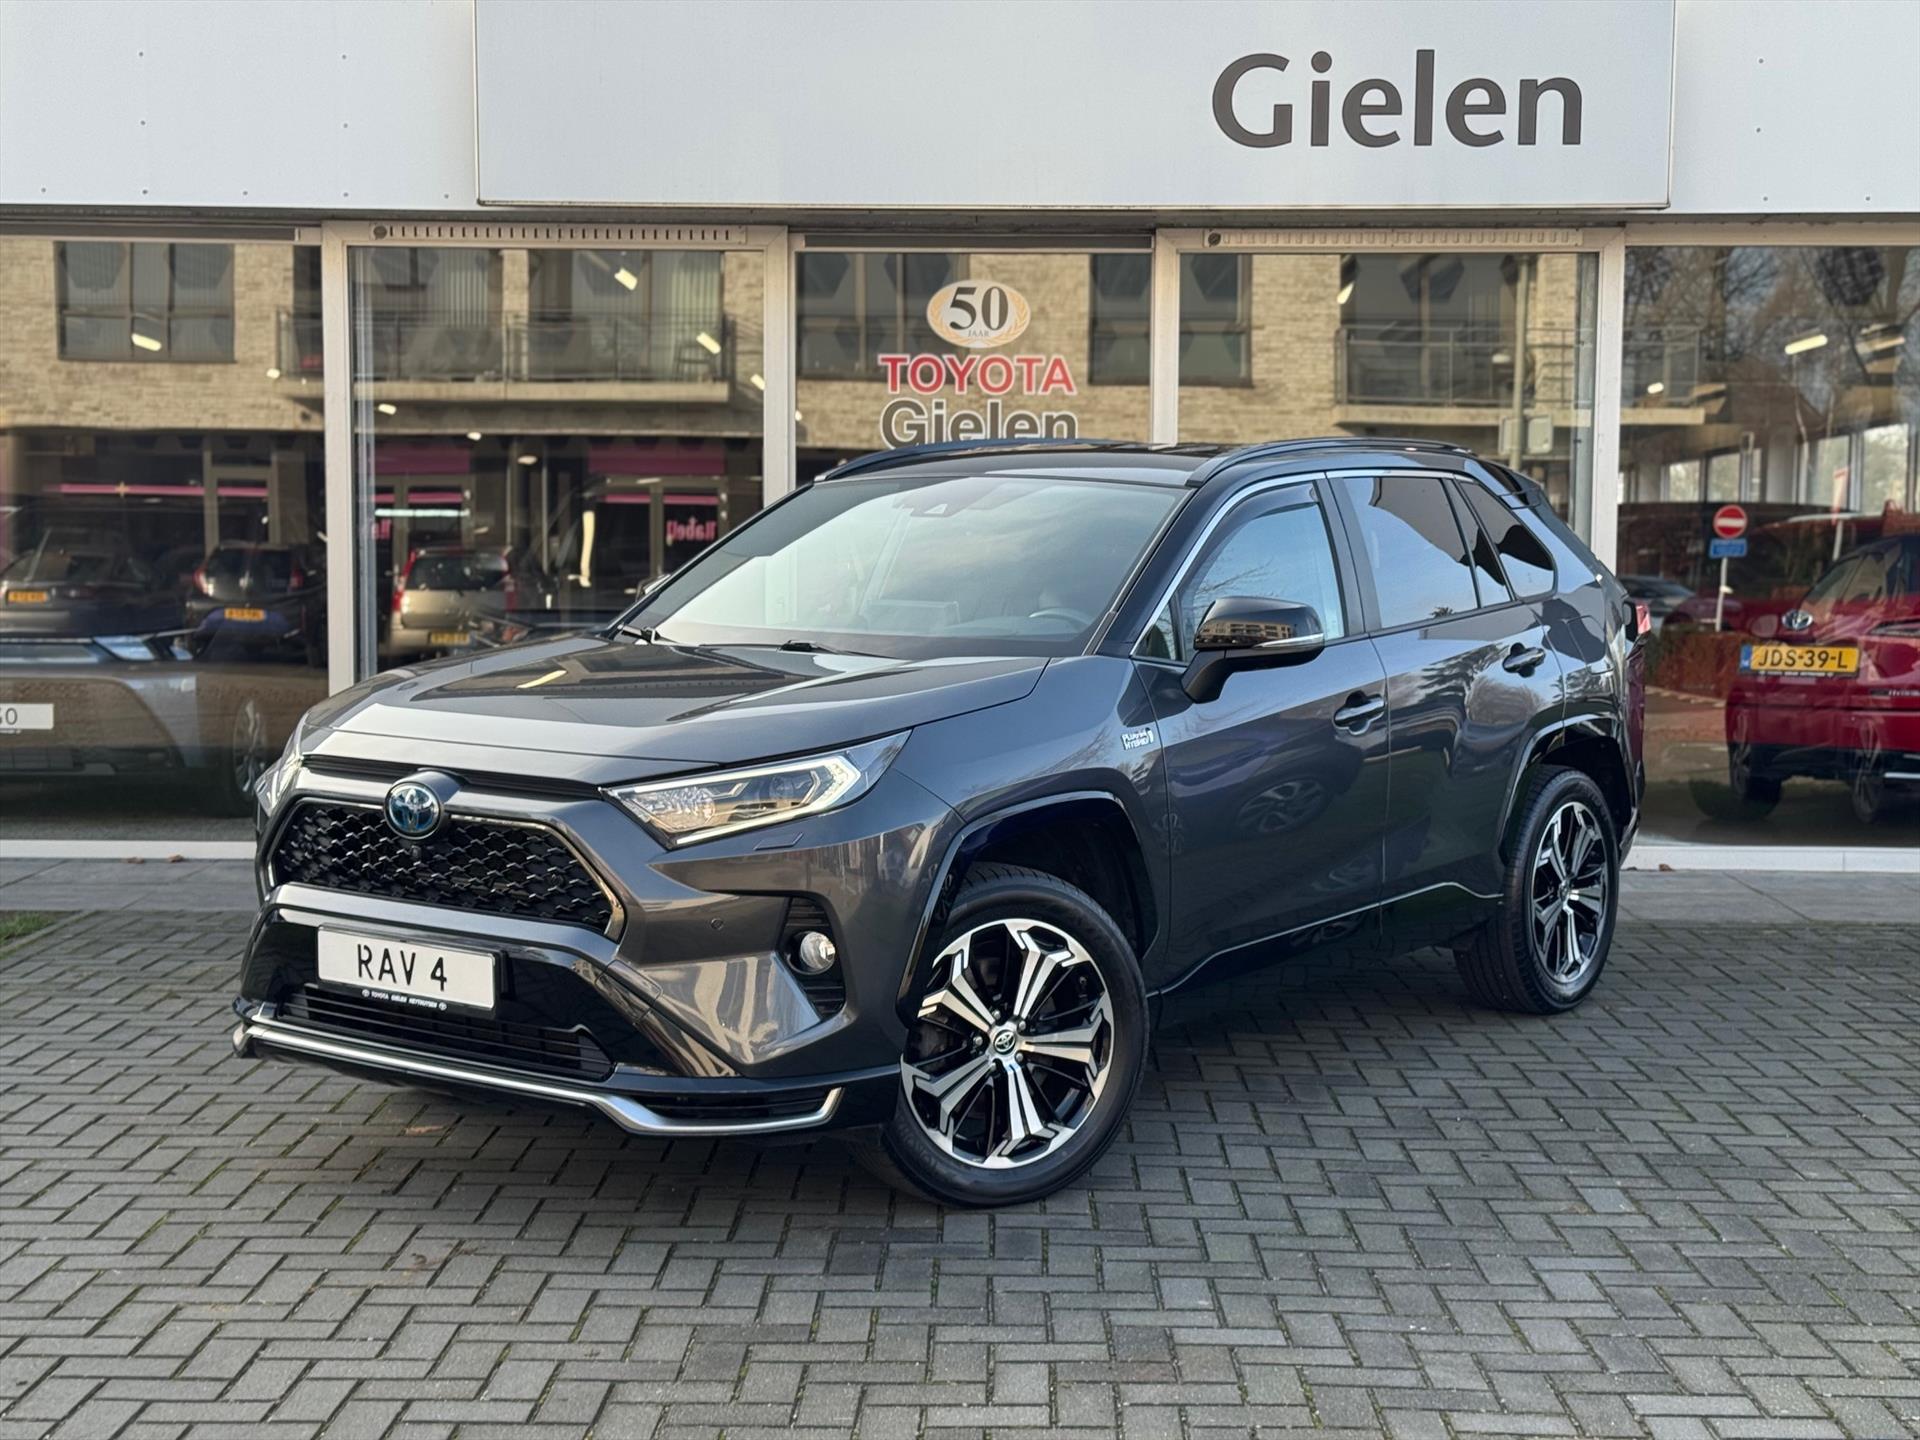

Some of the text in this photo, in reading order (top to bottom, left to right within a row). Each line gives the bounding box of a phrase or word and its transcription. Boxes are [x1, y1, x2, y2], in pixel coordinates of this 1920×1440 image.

[1212, 49, 1582, 148] Gielen
[949, 286, 1009, 331] 50
[967, 330, 990, 338] JAAR
[878, 354, 1076, 395] TOYOTA
[881, 398, 1077, 449] Gielen
[1758, 650, 1848, 669] JDS-39-L
[357, 944, 447, 991] RAV 4
[371, 990, 389, 1000] TOYOTA
